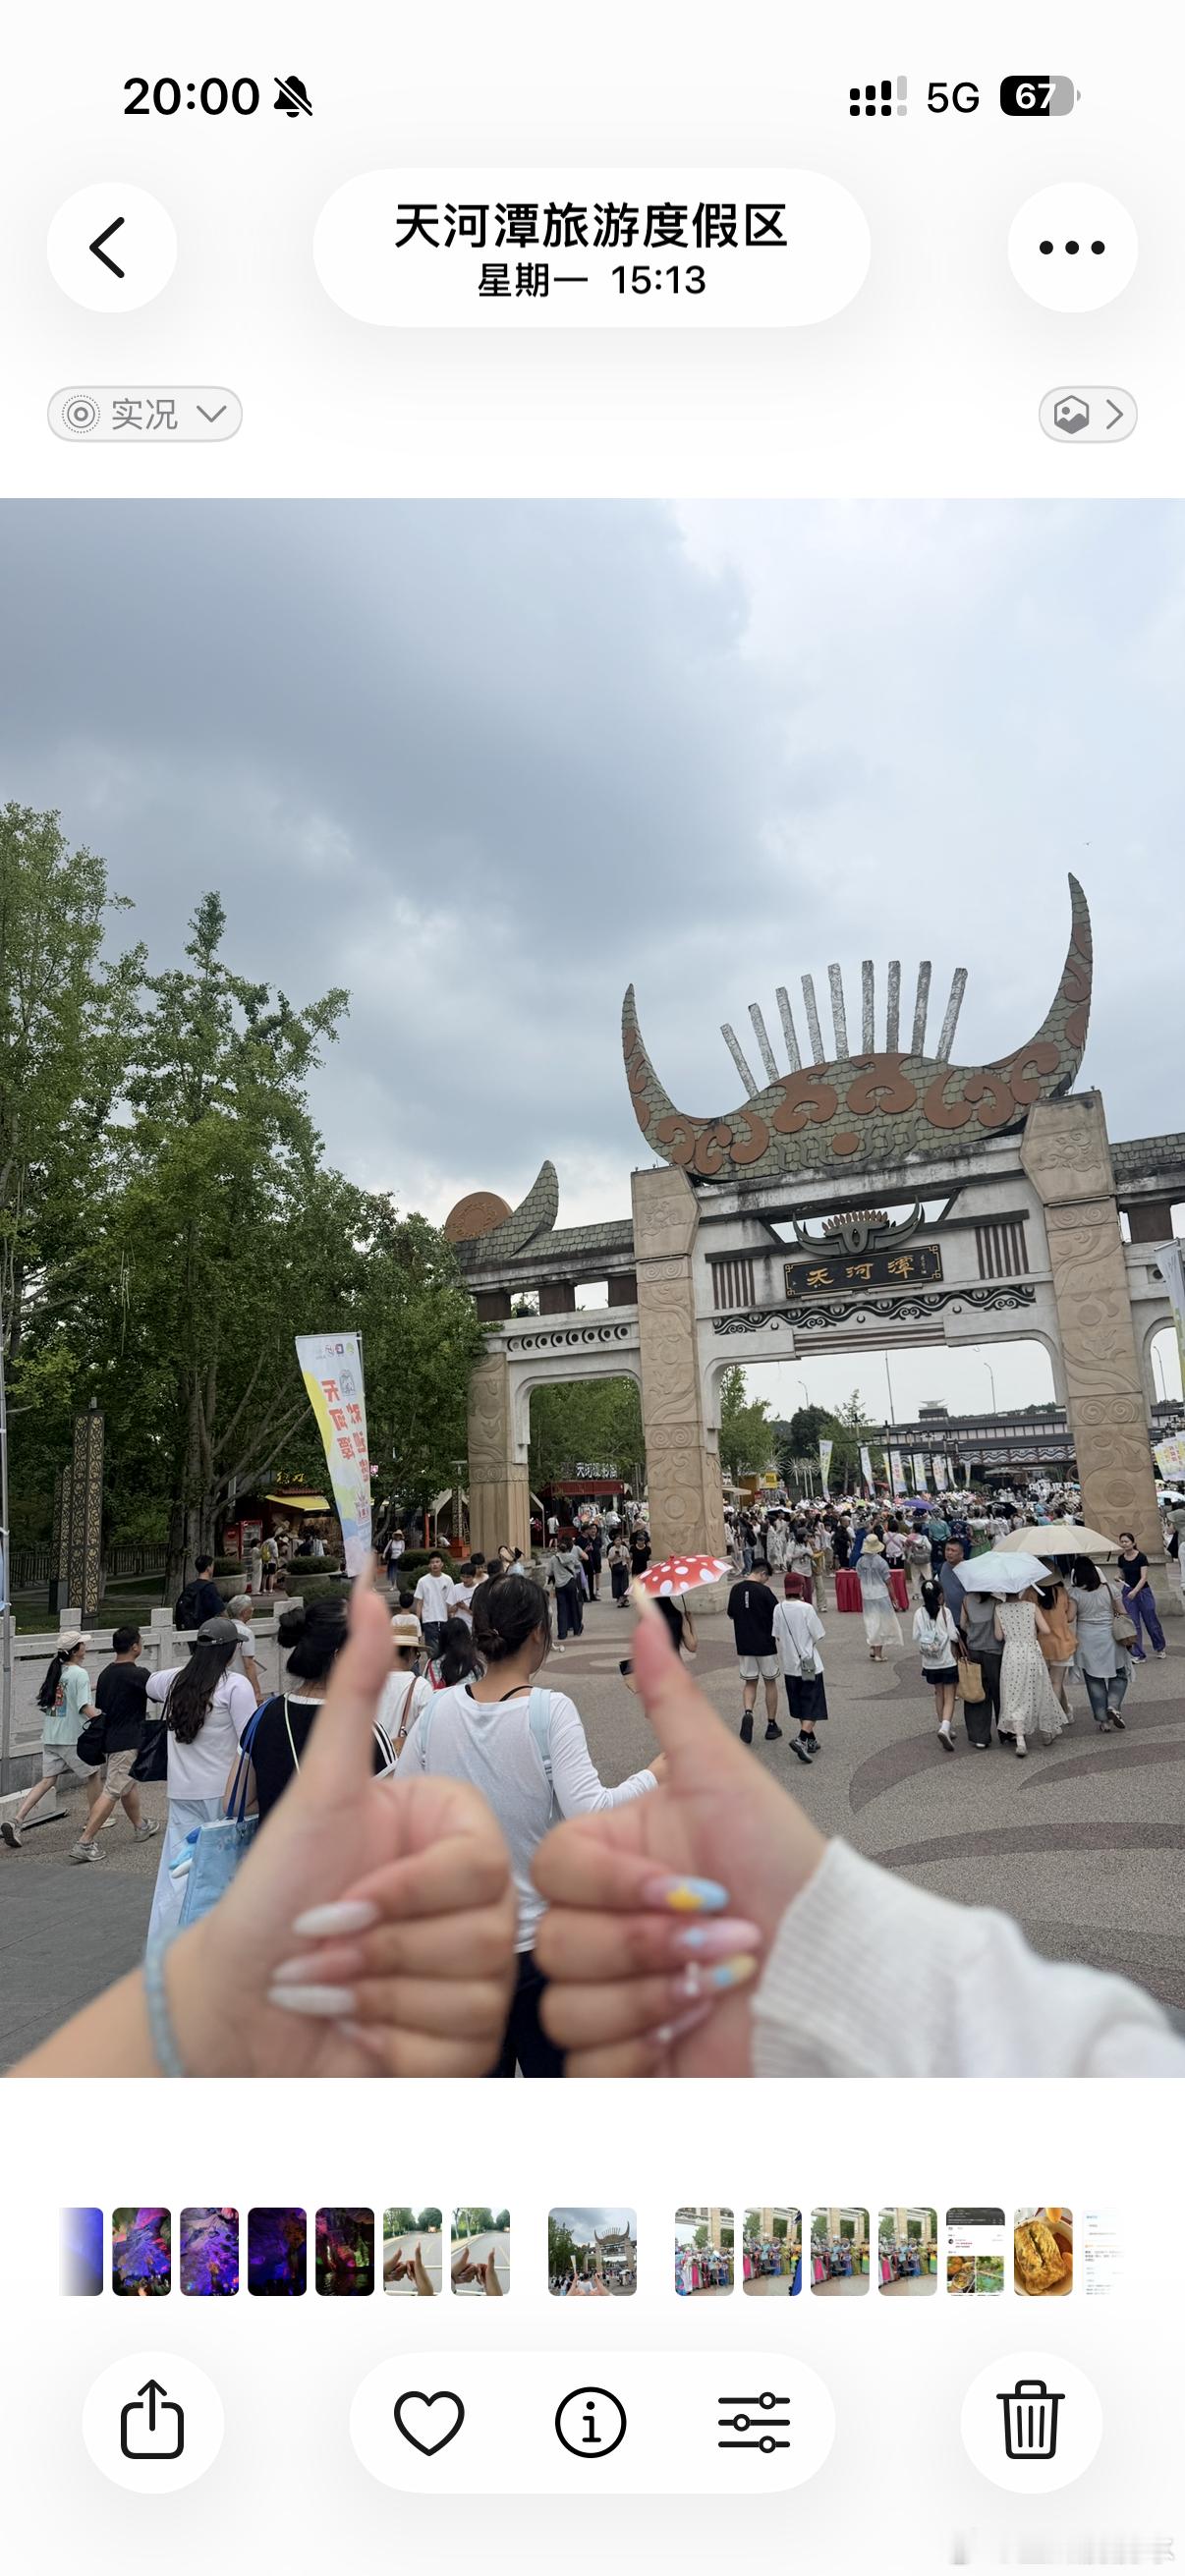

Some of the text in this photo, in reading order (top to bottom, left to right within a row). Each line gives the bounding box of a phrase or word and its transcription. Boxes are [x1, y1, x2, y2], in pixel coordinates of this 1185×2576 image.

[124, 77, 260, 116] 20:00
[927, 82, 980, 114] 5G
[1015, 82, 1057, 110] 67
[394, 201, 788, 249] 天河潭旅游度假区
[478, 261, 706, 298] 星期一 15:13
[111, 397, 179, 431] 实况
[806, 1255, 915, 1286] 天河潭
